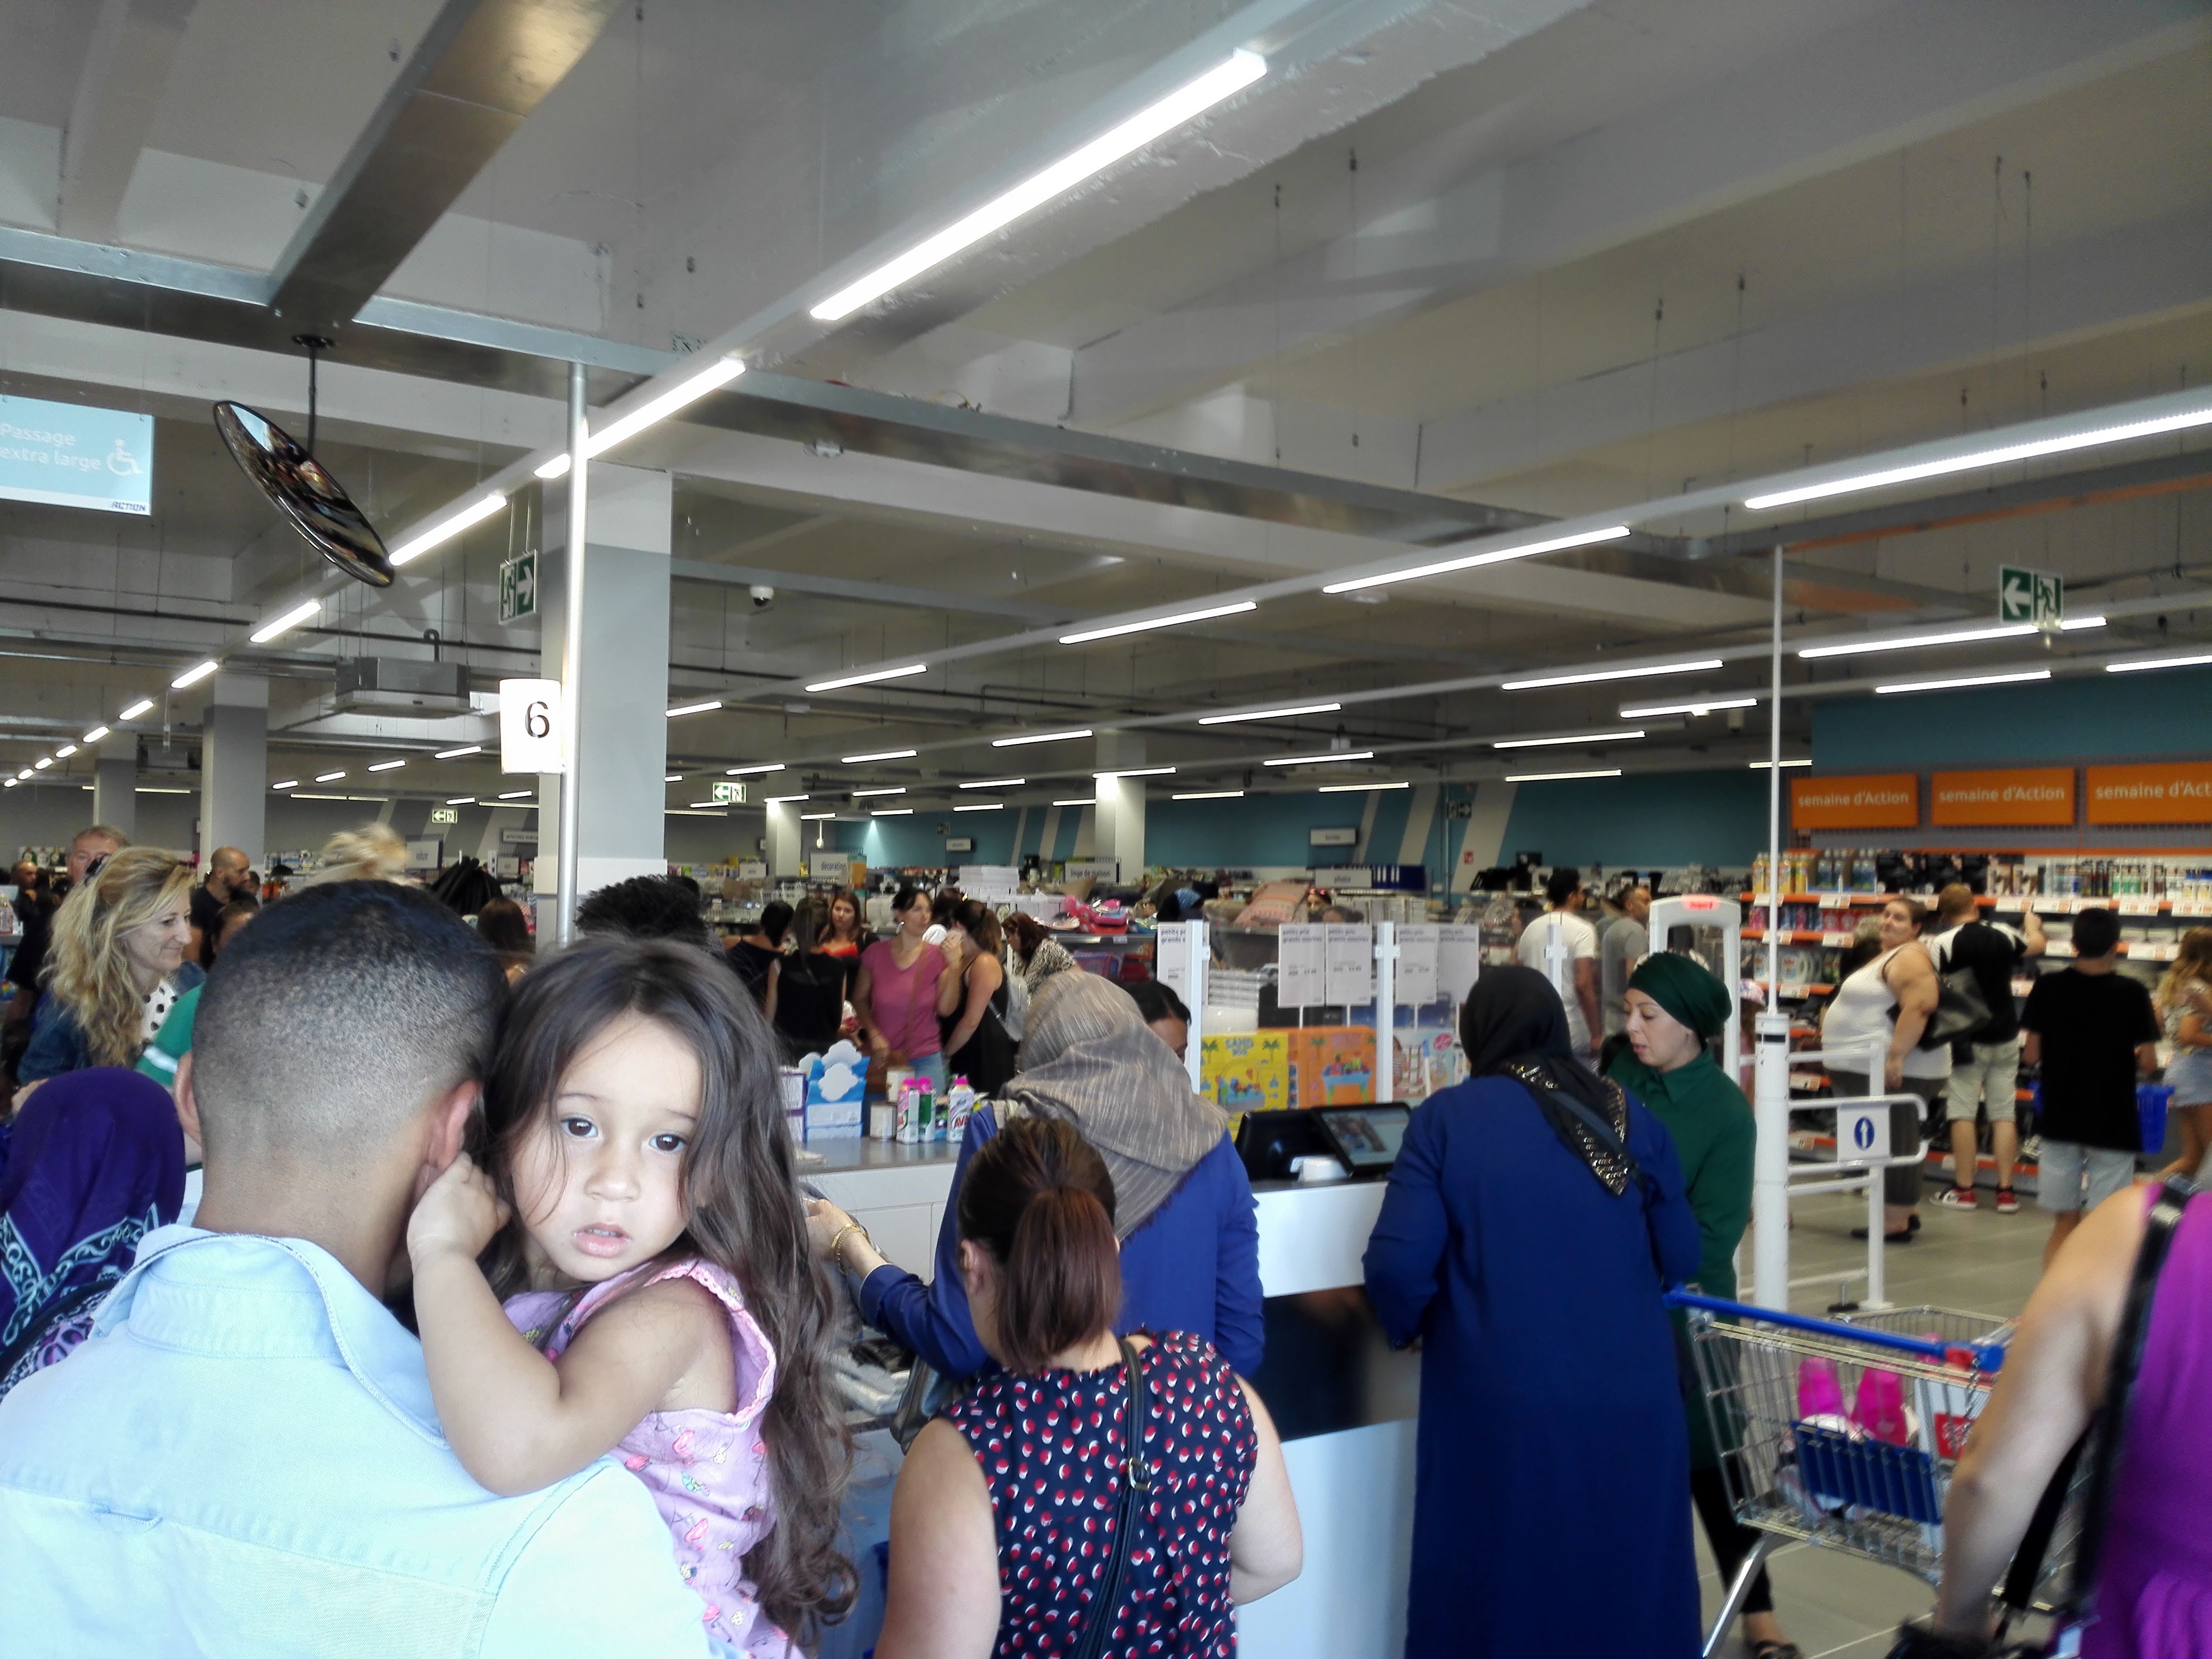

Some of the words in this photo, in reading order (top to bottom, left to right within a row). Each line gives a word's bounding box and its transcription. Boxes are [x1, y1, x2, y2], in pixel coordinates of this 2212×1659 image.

[0, 446, 48, 464] extra
[54, 449, 101, 472] large
[111, 501, 146, 512] ACTION
[525, 701, 550, 738] 6
[1799, 793, 1850, 807] semaine
[1854, 791, 1909, 805] d'Action
[1940, 787, 1999, 803] semaine
[2002, 784, 2065, 802] d'Action
[2096, 781, 2164, 800] semaine
[1070, 868, 1083, 878] linge
[1084, 868, 1091, 877] de
